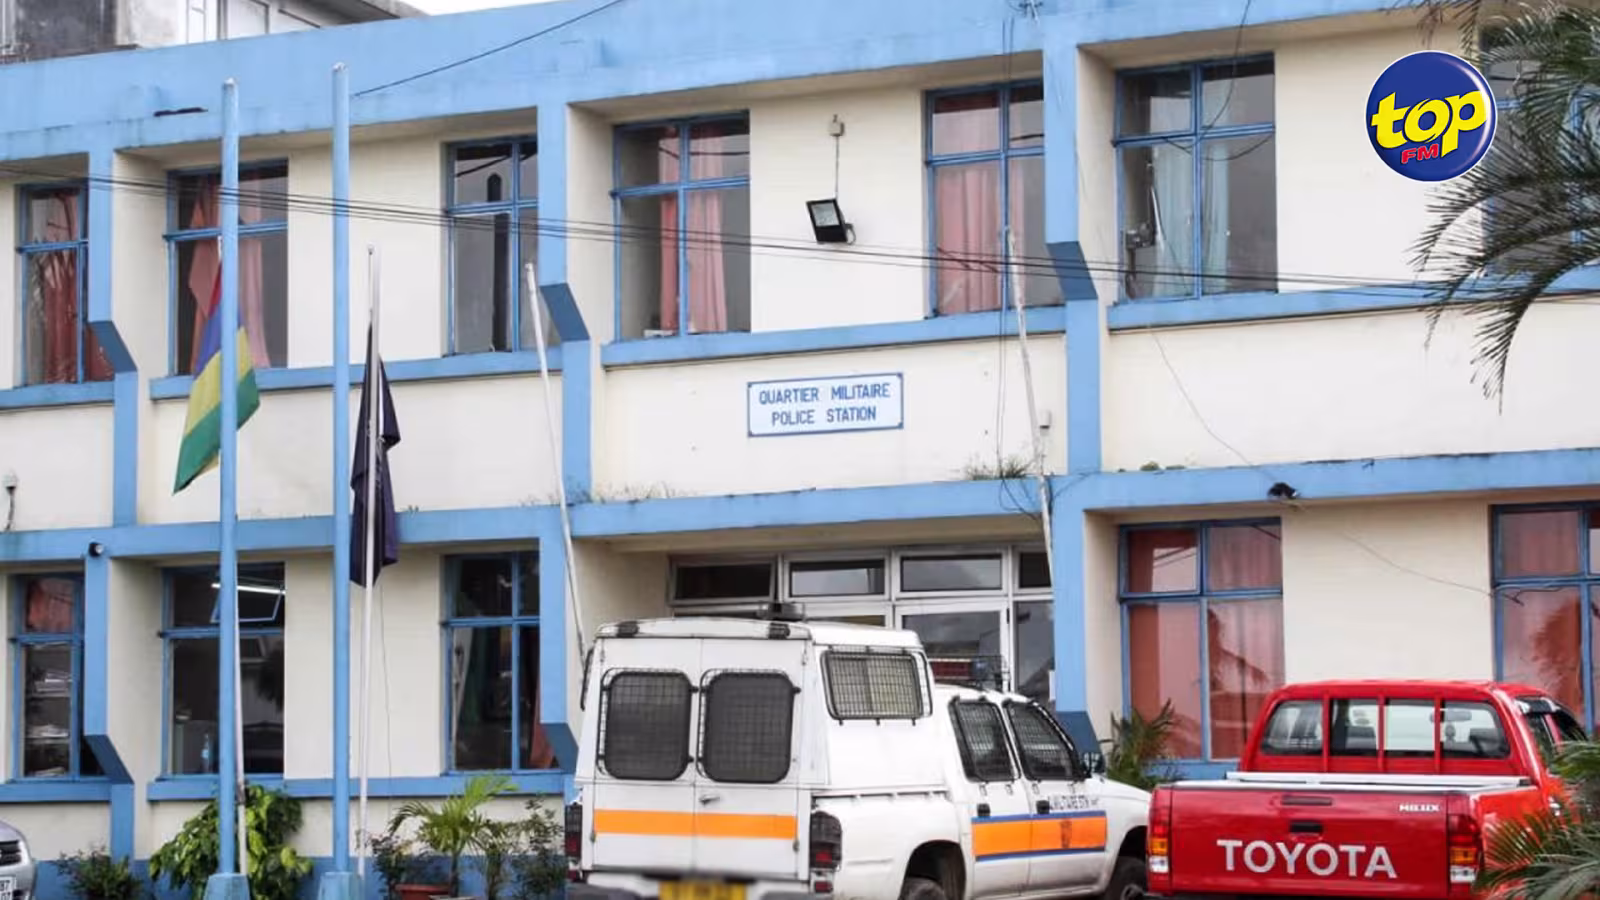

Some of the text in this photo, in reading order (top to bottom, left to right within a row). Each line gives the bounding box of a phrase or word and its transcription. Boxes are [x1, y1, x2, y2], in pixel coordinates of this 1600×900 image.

[759, 382, 890, 405] QUARTIER MILITAIRE
[771, 405, 876, 426] POLICE STATION
[1216, 839, 1397, 879] TOYOTA
